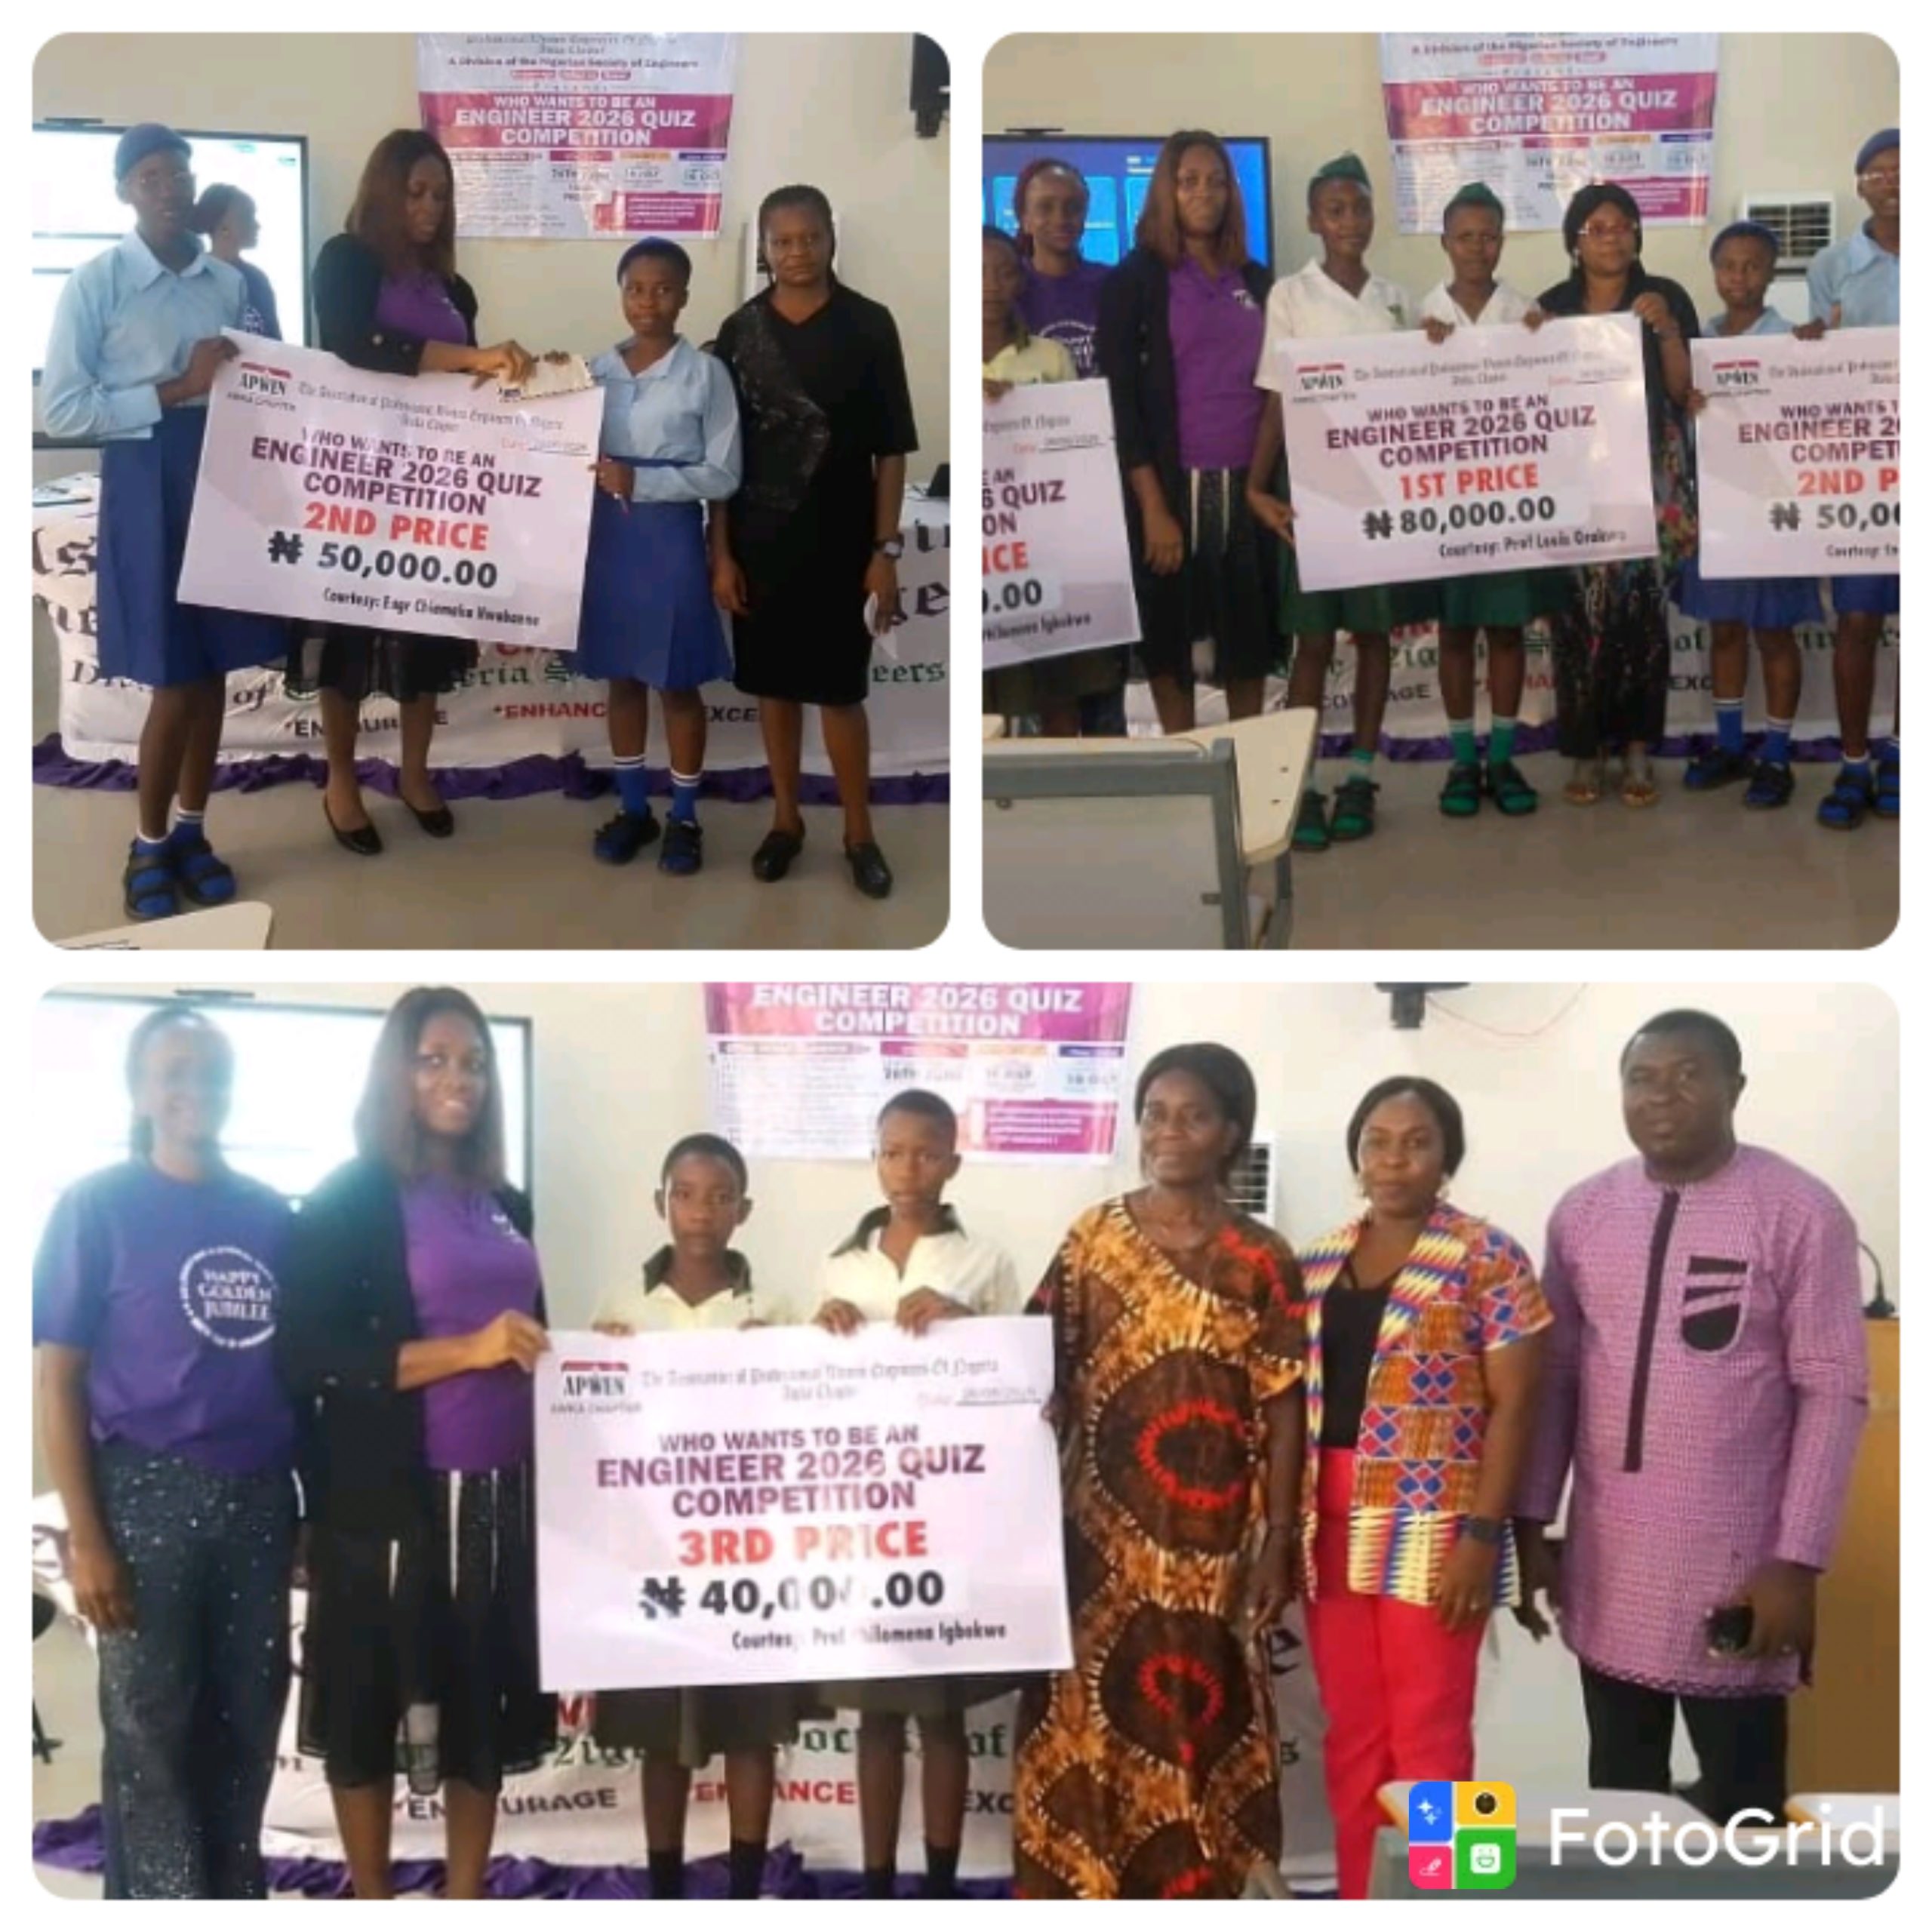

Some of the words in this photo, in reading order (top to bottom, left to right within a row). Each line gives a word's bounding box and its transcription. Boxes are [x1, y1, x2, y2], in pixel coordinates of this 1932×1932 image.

[1561, 79, 1581, 92] TO
[1586, 78, 1607, 91] BE
[1611, 78, 1635, 90] AN
[494, 96, 529, 107] WHO
[534, 96, 584, 108] WANTS
[589, 97, 607, 108] TO
[611, 97, 631, 108] BE
[634, 97, 656, 108] AN
[1420, 94, 1543, 116] ENGINEER
[1551, 92, 1612, 112] 2026
[1620, 90, 1678, 111] QUIZ
[454, 109, 570, 128] ENGINEER
[577, 110, 635, 128] 2026
[642, 110, 697, 129] QUIZ
[1470, 113, 1631, 134] COMPETITION
[501, 128, 651, 146] COMPETITION
[240, 372, 286, 395] APWEN
[1367, 408, 1407, 423] WHO
[1411, 400, 1469, 417] WANTS
[1473, 398, 1494, 413] TO
[1499, 396, 1520, 411] BE
[1526, 394, 1548, 409] AN
[1780, 404, 1821, 420] WHO
[1826, 399, 1887, 416] WANTS
[1890, 399, 1900, 413] T
[1326, 418, 1456, 450] ENGINEER
[1463, 413, 1527, 436] 2026
[1534, 405, 1596, 432] QUIZ
[1737, 419, 1871, 444] ENGINEER
[351, 434, 411, 458] WNTS
[417, 445, 438, 462] TO
[471, 453, 496, 469] AN
[1379, 434, 1548, 468] COMPETITION
[1791, 439, 1900, 463] COMPET
[251, 435, 394, 478] ENGINEER
[401, 460, 469, 489] 2026
[477, 470, 543, 498] QUIZ
[303, 471, 487, 516] COMPETITION
[1001, 480, 1066, 511] QUIZ
[1401, 472, 1446, 501] 1ST
[1456, 463, 1539, 495] PRICE
[1797, 468, 1864, 497] 2ND
[1878, 467, 1900, 493] P
[304, 501, 377, 537] 2ND
[389, 513, 490, 552] PRICE
[982, 512, 1017, 537] ON
[1400, 495, 1555, 535] 80,000.00
[1503, 534, 1533, 552] Prof
[318, 540, 498, 589] 50,000.00
[982, 541, 1029, 577] ICE
[324, 587, 380, 611] Courtesy:
[494, 702, 608, 721] ENHANC
[751, 983, 910, 1008] ENGINEER
[918, 986, 998, 1010] 2026
[1008, 989, 1084, 1015] QUIZ
[815, 1011, 1021, 1035] COMPETITION
[563, 1374, 626, 1396] APWEN
[659, 1432, 716, 1453] WHO
[724, 1429, 805, 1451] WANTS
[811, 1427, 841, 1447] TO
[847, 1426, 878, 1446] BE
[885, 1424, 919, 1444] AN
[596, 1453, 786, 1487] ENGINEER
[796, 1447, 886, 1481] 2026
[897, 1443, 986, 1481] QUIZ
[672, 1481, 916, 1518] COMPETITION
[678, 1526, 774, 1567] 3RD
[793, 1520, 929, 1561] PRICE
[731, 1630, 796, 1652] Courtes
[394, 1787, 617, 1820] ENURAGE
